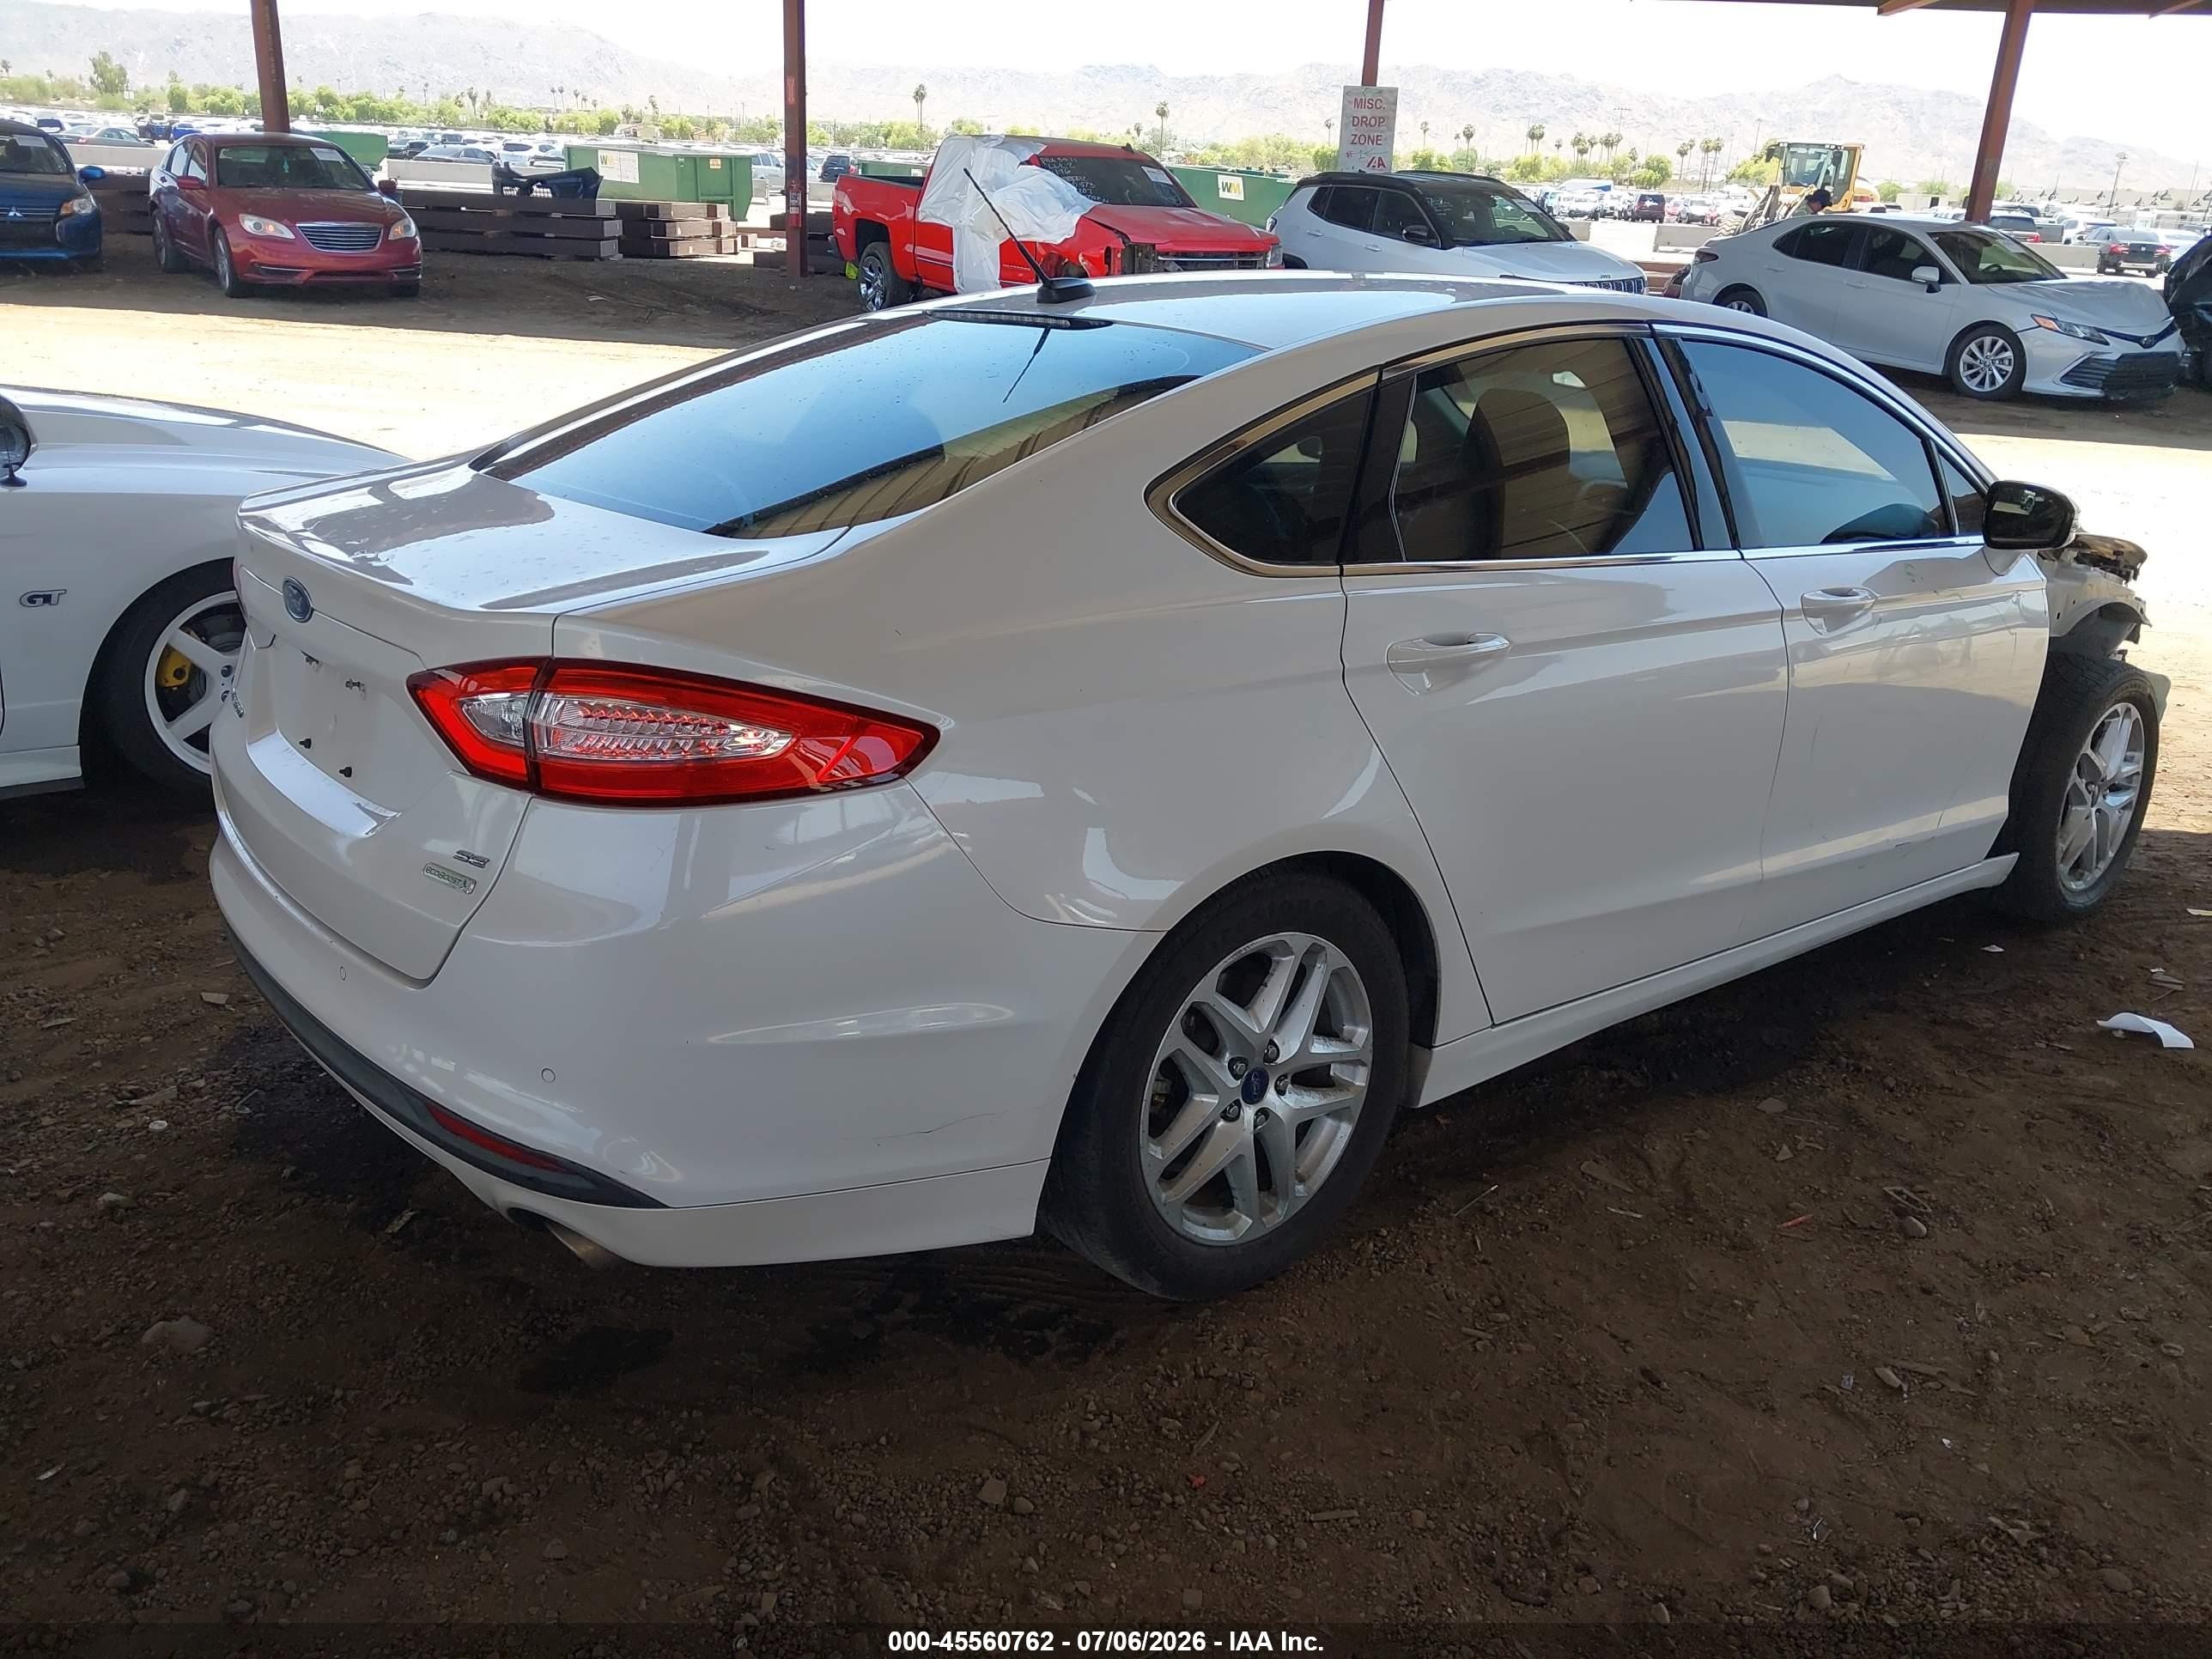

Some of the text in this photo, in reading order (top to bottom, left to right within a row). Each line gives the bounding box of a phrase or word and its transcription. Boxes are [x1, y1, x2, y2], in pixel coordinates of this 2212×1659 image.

[1353, 98, 1386, 110] MISC.
[1352, 116, 1385, 127] DROP
[1350, 133, 1382, 145] ZONE
[1221, 181, 1241, 193] WM
[19, 588, 67, 608] GT
